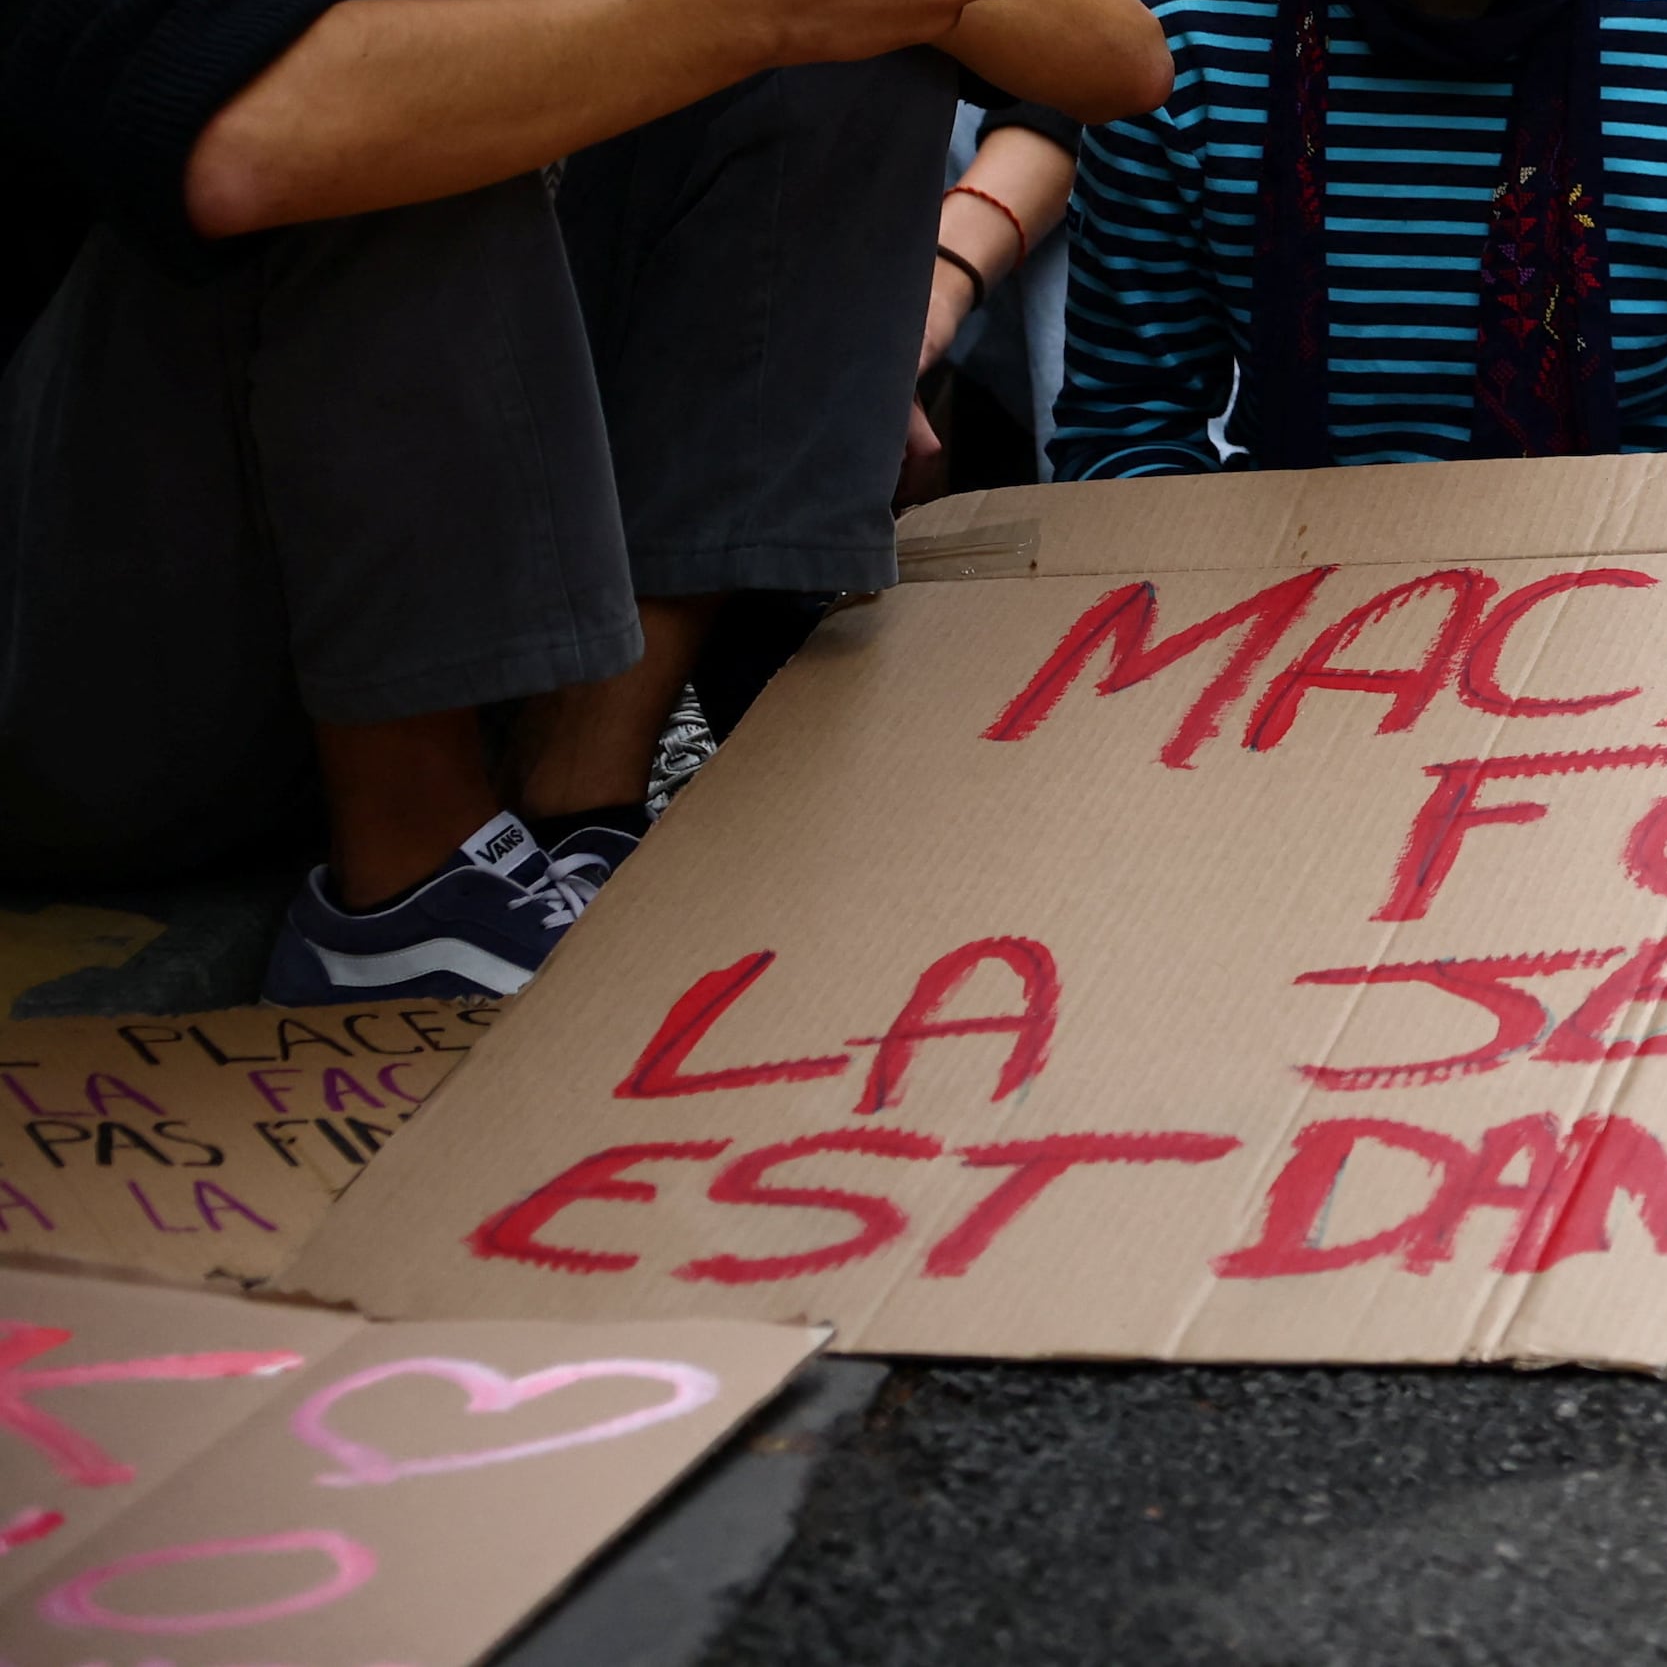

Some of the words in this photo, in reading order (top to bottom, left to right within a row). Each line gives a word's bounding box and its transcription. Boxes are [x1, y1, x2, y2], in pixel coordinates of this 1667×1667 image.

[475, 824, 525, 865] VANS
[613, 935, 1062, 1114] LA
[23, 1119, 225, 1168] PAS
[127, 1179, 279, 1232] LA
[461, 1126, 1243, 1286] EST
